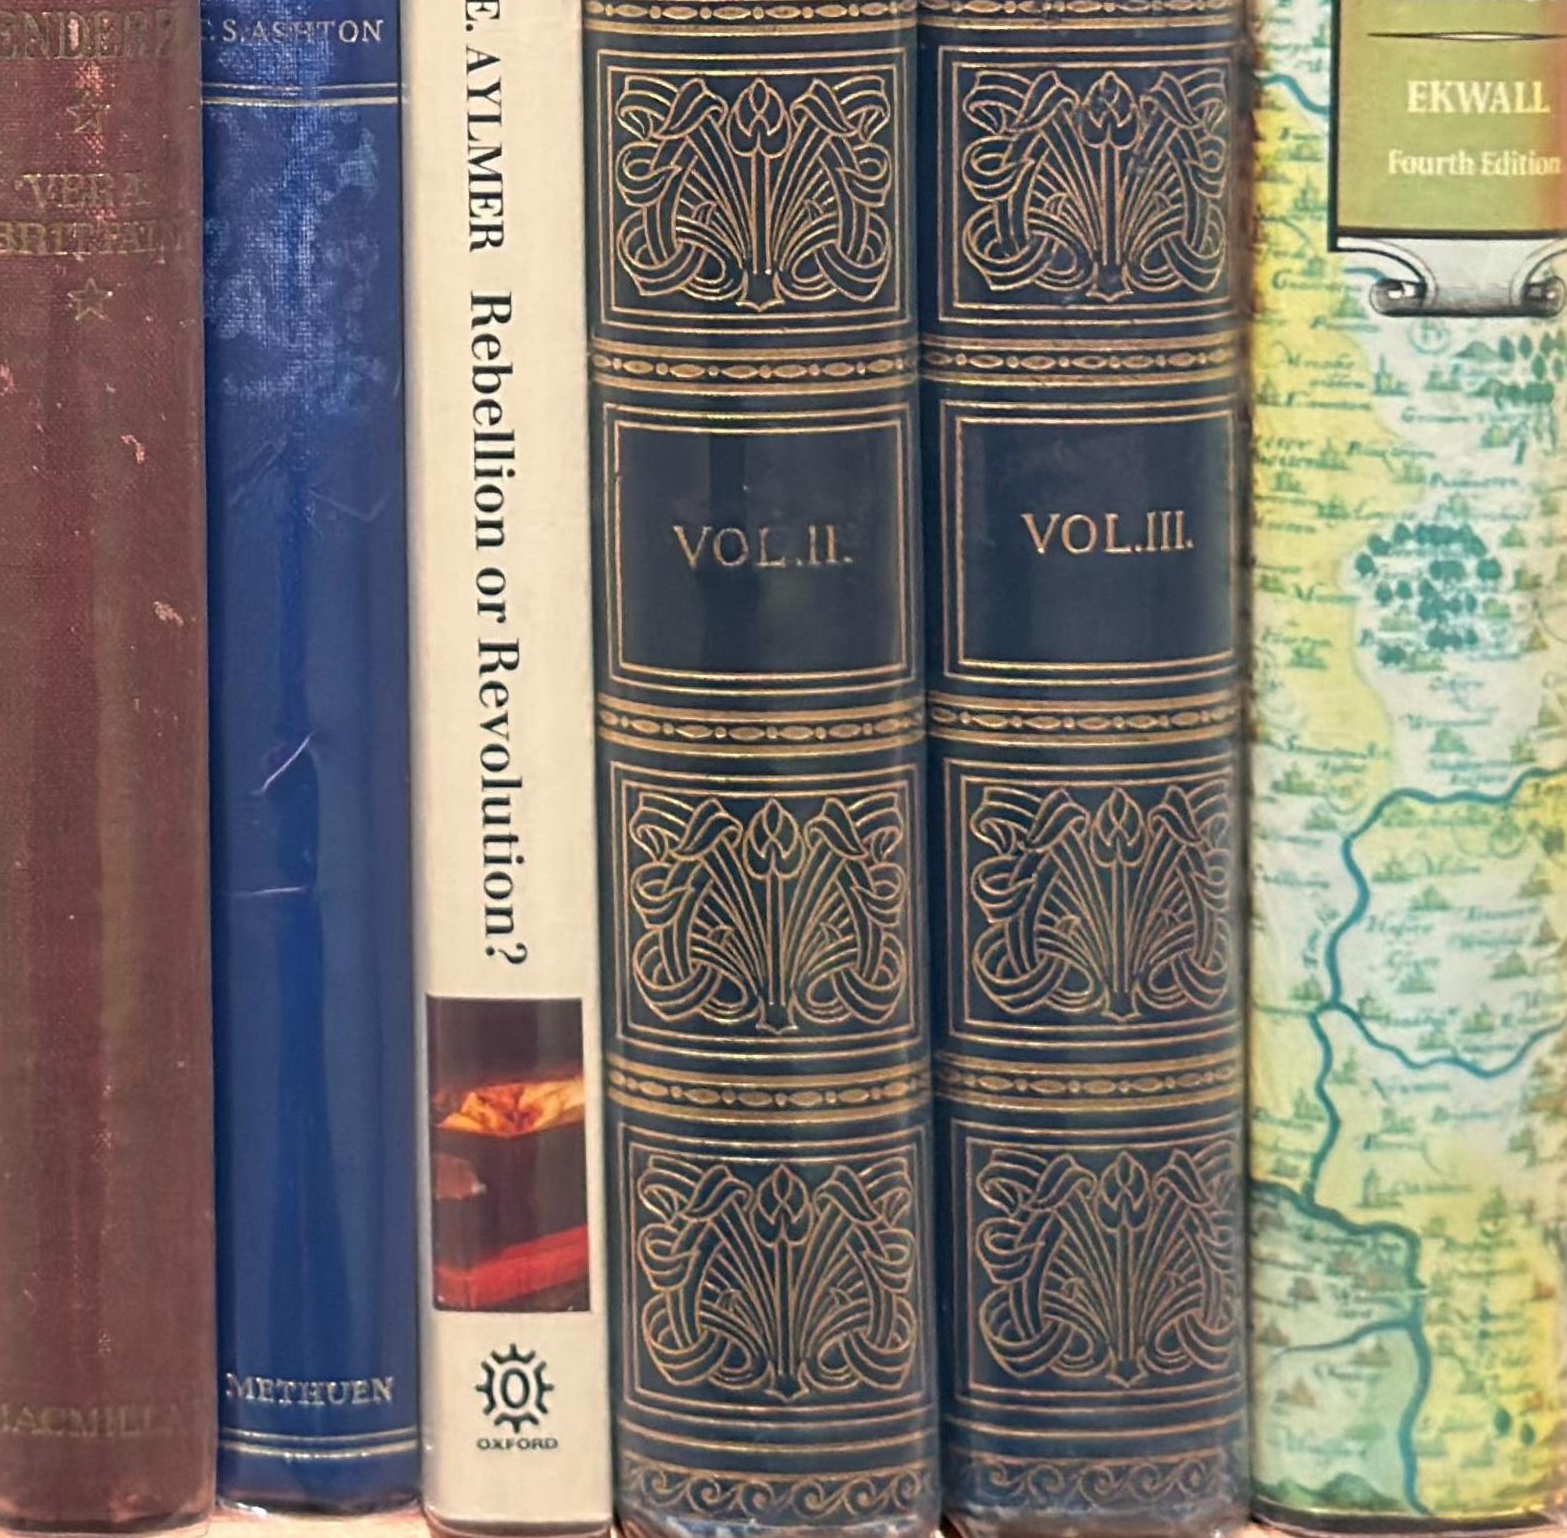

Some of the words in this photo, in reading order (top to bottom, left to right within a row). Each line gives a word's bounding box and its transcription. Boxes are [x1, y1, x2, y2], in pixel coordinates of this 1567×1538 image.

[1406, 79, 1551, 115] EKWALL
[466, 47, 505, 253] AYLMER
[1387, 149, 1475, 177] Fourth
[1480, 149, 1564, 177] Edition
[21, 173, 152, 209] VERA
[471, 291, 516, 550] Rebellion
[475, 567, 507, 624] or
[477, 638, 528, 966] Revolution?
[226, 1372, 394, 1406] METHUEN
[476, 1437, 558, 1450] OXFORD
